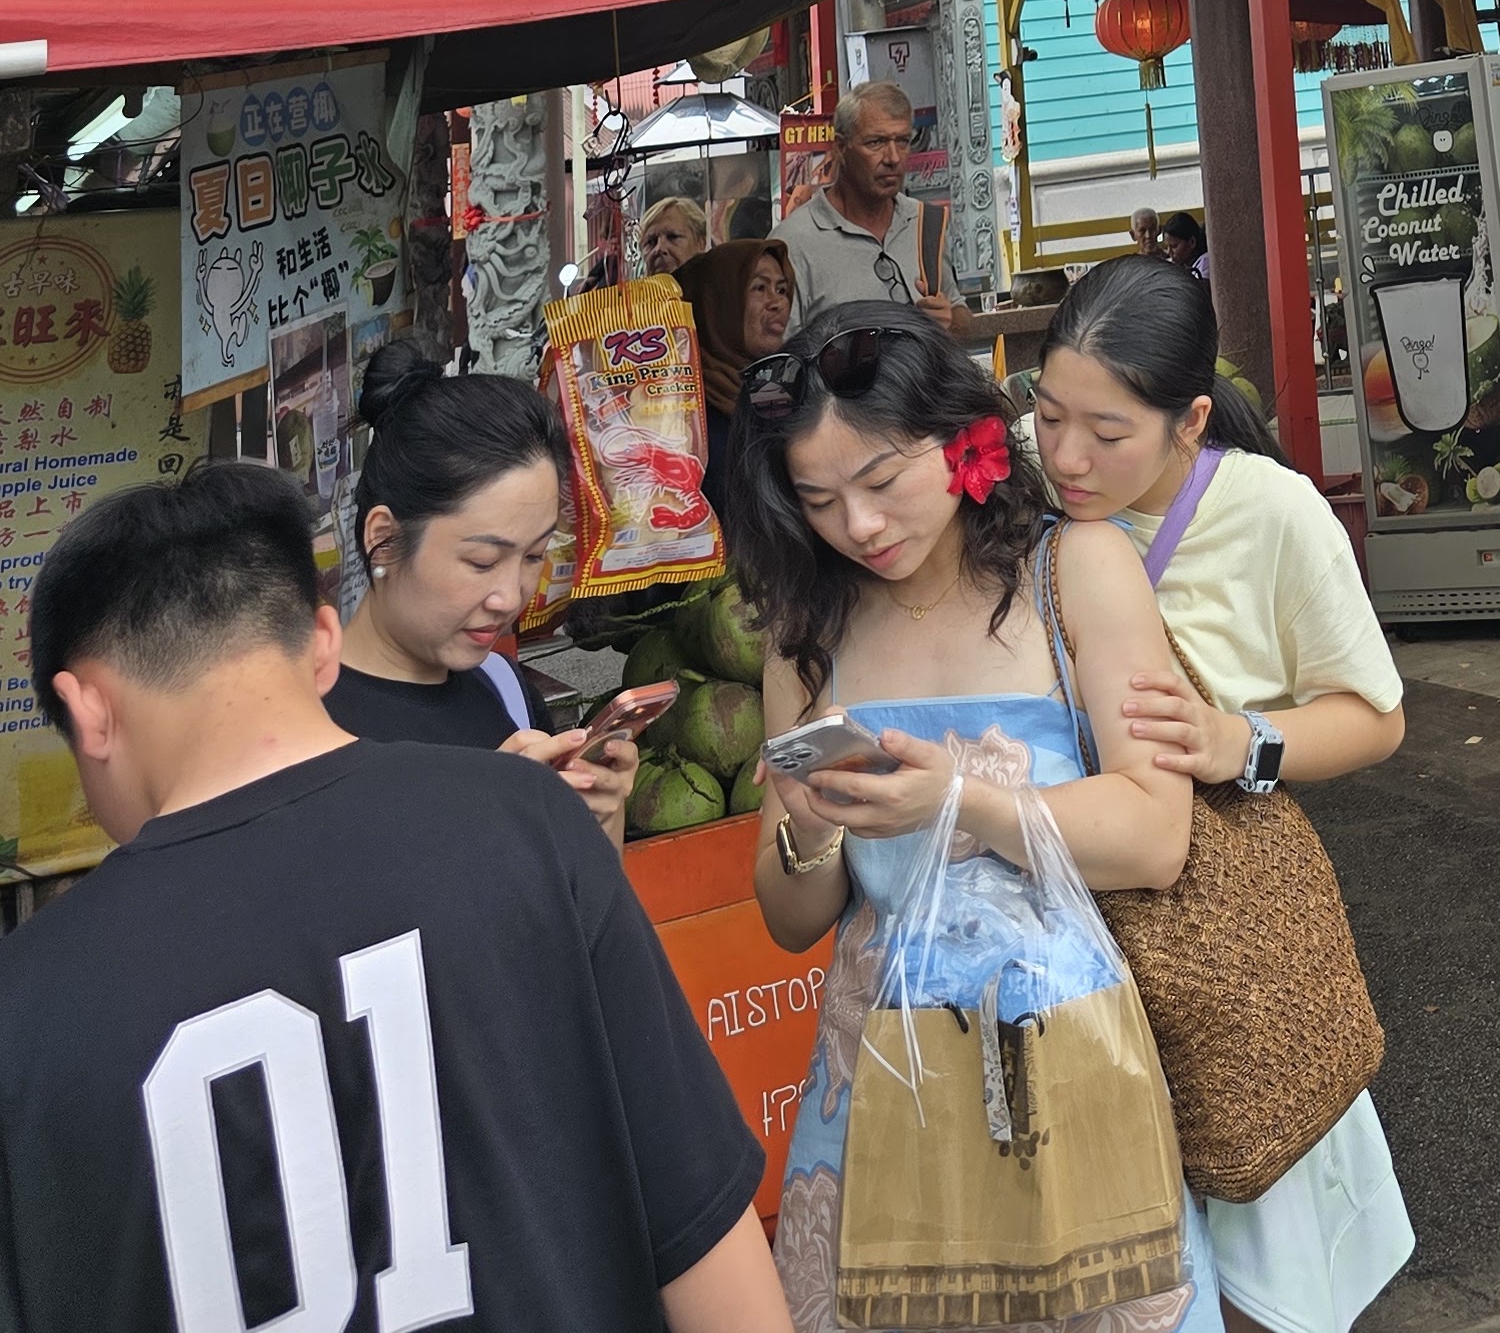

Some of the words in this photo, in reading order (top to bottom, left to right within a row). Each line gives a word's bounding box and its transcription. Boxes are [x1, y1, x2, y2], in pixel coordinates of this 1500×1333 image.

[243, 89, 338, 140] 正在营椰
[784, 127, 805, 144] GT
[189, 130, 396, 245] 夏日椰子水
[1377, 173, 1464, 216] Chilled
[1362, 213, 1443, 244] Coconut
[277, 226, 332, 280] 和生活
[1389, 240, 1461, 267] Water
[3, 268, 80, 298] 古早味
[604, 327, 668, 366] KS
[590, 372, 637, 391] King
[638, 366, 693, 381] Prawn
[646, 381, 698, 396] Cracker
[34, 447, 138, 471] Homemade
[48, 474, 97, 489] Juice
[9, 575, 33, 591] try
[142, 927, 474, 1333] 01
